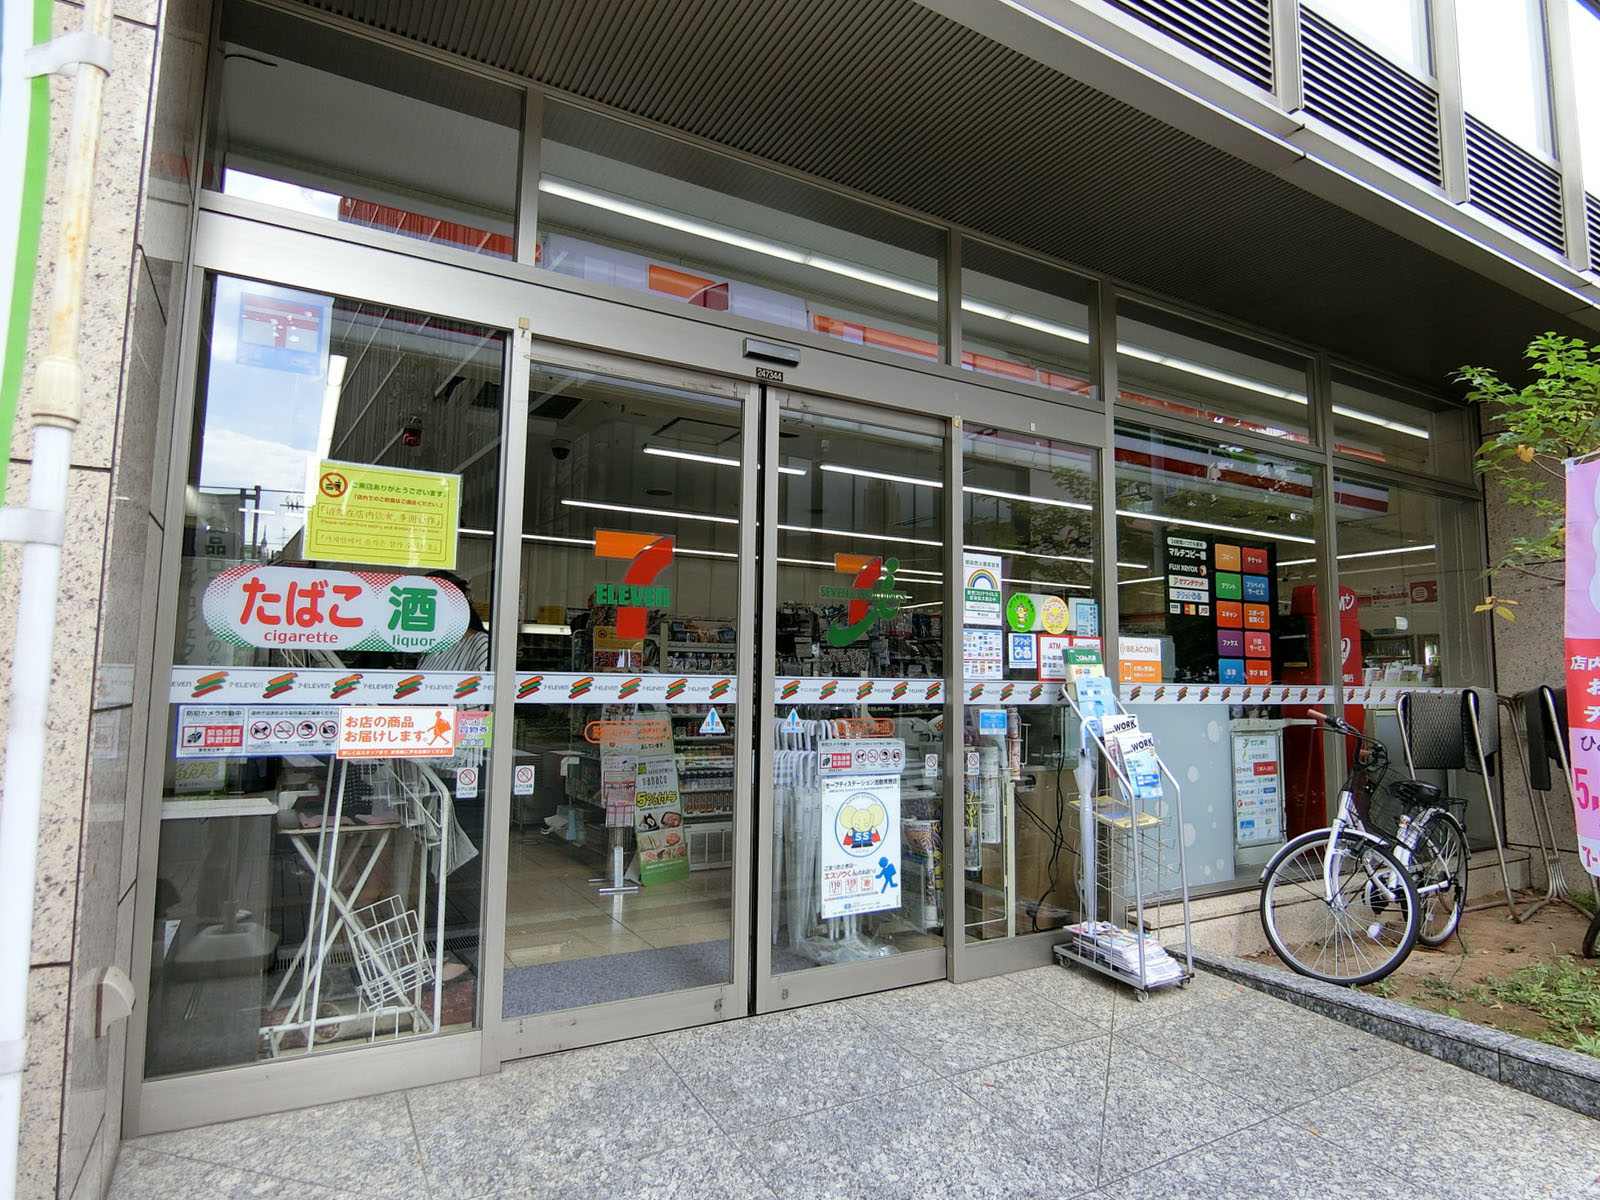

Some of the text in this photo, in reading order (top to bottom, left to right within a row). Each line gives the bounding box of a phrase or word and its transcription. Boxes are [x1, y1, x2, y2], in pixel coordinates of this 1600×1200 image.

[239, 576, 438, 632] たばこ 酒
[263, 629, 339, 645] cigarette
[391, 634, 437, 649] liquor
[1048, 642, 1062, 650] ATM
[229, 681, 264, 689] 7-ELEVEN
[363, 683, 394, 691] 7-ELEVEN
[345, 715, 415, 729] お店の商品
[1113, 719, 1137, 732] WORK
[344, 729, 428, 744] お届けします。
[1130, 737, 1154, 752] WORK
[636, 791, 677, 808] 5%付与
[855, 831, 870, 841] SS
